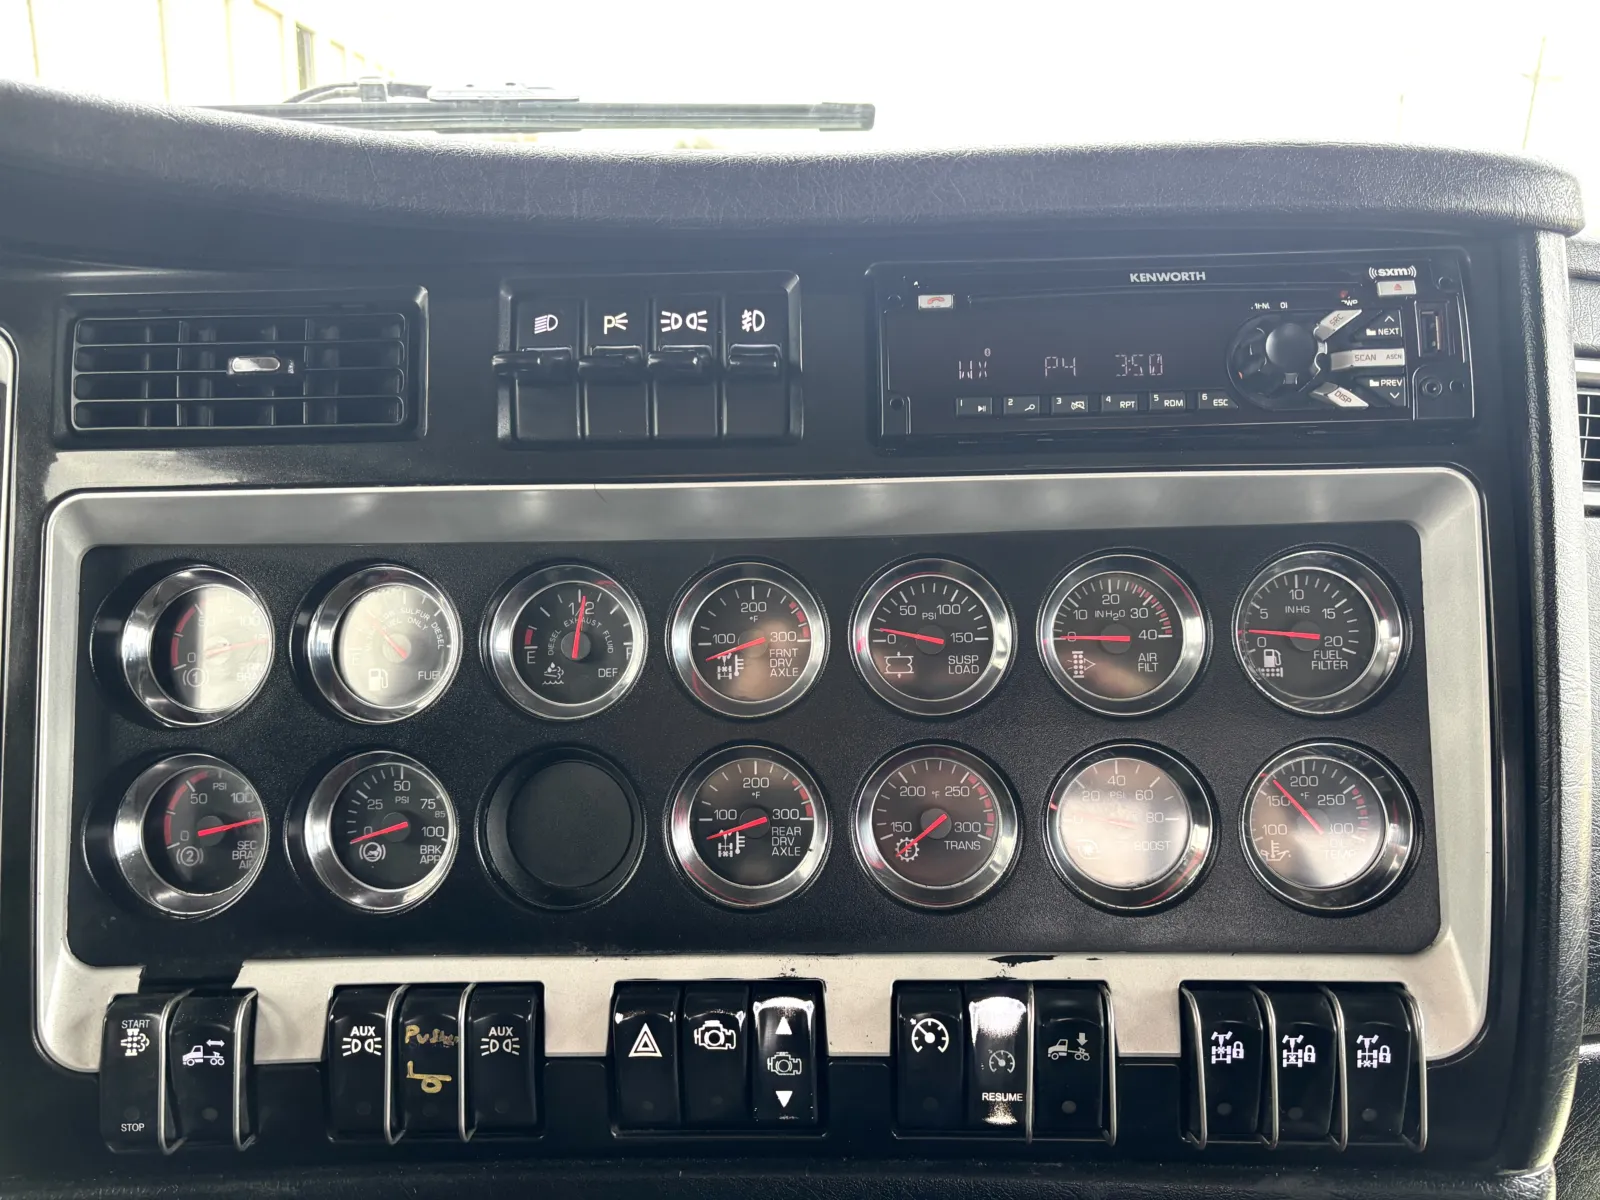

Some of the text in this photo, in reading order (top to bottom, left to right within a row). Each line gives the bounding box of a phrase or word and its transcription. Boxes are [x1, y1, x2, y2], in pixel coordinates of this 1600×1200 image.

[1129, 271, 1206, 283] KENWORTH
[1378, 267, 1407, 277] sxm
[1329, 314, 1344, 326] SRC
[1378, 328, 1400, 336] NEXT
[1354, 354, 1377, 362] SCAN
[1044, 356, 1077, 378] P4
[1115, 354, 1163, 377] 3:50
[1008, 398, 1014, 406] 2
[1154, 394, 1159, 402] 5
[1334, 390, 1352, 404] DISP
[1120, 401, 1135, 409] RPT
[1213, 399, 1228, 407] ESC
[1102, 594, 1120, 604] 20
[1289, 589, 1304, 600] 10
[740, 602, 767, 613] 200
[900, 605, 917, 616] 50
[936, 604, 961, 615] 100
[922, 612, 936, 620] PSI
[1073, 609, 1087, 620] 10
[1130, 608, 1149, 619] 30
[1260, 608, 1269, 619] 5
[1322, 608, 1336, 619] 15
[401, 607, 431, 621] SULFUR
[431, 622, 445, 650] DIESEL
[408, 617, 428, 631] ONLY
[548, 618, 613, 656] DIESEL EXHAUST FLUID
[713, 634, 736, 644] 100
[770, 631, 796, 642] 300
[887, 634, 896, 644] 0
[950, 632, 973, 643] 150
[1138, 630, 1158, 640] 40
[1257, 637, 1267, 648] 0
[1324, 636, 1343, 646] 20
[187, 652, 196, 663] 0
[526, 651, 536, 664] E
[769, 648, 799, 658] FRNT
[1138, 652, 1157, 662] AIR
[1314, 650, 1342, 660] FUEL
[770, 658, 792, 667] DRV
[948, 655, 979, 665] SUSP
[1311, 660, 1348, 670] FILTER
[770, 668, 799, 677] AXLE
[948, 665, 980, 675] LOAD
[1138, 663, 1158, 672] FILT
[598, 668, 618, 678] DEF
[743, 778, 769, 788] 200
[1107, 775, 1126, 786] 40
[1290, 776, 1318, 787] 200
[213, 783, 227, 791] PSI
[393, 781, 411, 791] 50
[900, 786, 926, 797] 200
[944, 786, 970, 797] 250
[1082, 790, 1100, 801] 20
[1135, 790, 1153, 800] 60
[190, 793, 207, 804] 50
[230, 792, 254, 803] 100
[395, 796, 409, 804] PSI
[1266, 795, 1291, 807] 150
[1317, 794, 1345, 806] 250
[367, 799, 383, 810] 25
[420, 798, 436, 810] 75
[714, 809, 737, 820] 100
[772, 808, 800, 819] 300
[1146, 812, 1164, 823] 80
[422, 826, 445, 837] 100
[771, 826, 801, 836] REAR
[890, 822, 912, 832] 150
[954, 822, 981, 832] 300
[1262, 824, 1287, 835] 100
[180, 831, 189, 841] 0
[237, 841, 258, 850] SEC
[771, 837, 794, 846] DRV
[944, 840, 981, 850] TRANS
[1133, 840, 1171, 850] BOOST
[420, 845, 442, 854] BRK
[771, 847, 801, 856] AXLE
[121, 1020, 150, 1030] START
[350, 1026, 376, 1036] AUX
[488, 1026, 514, 1037] AUX
[981, 1091, 1023, 1102] RESUME
[120, 1123, 145, 1133] STOP
